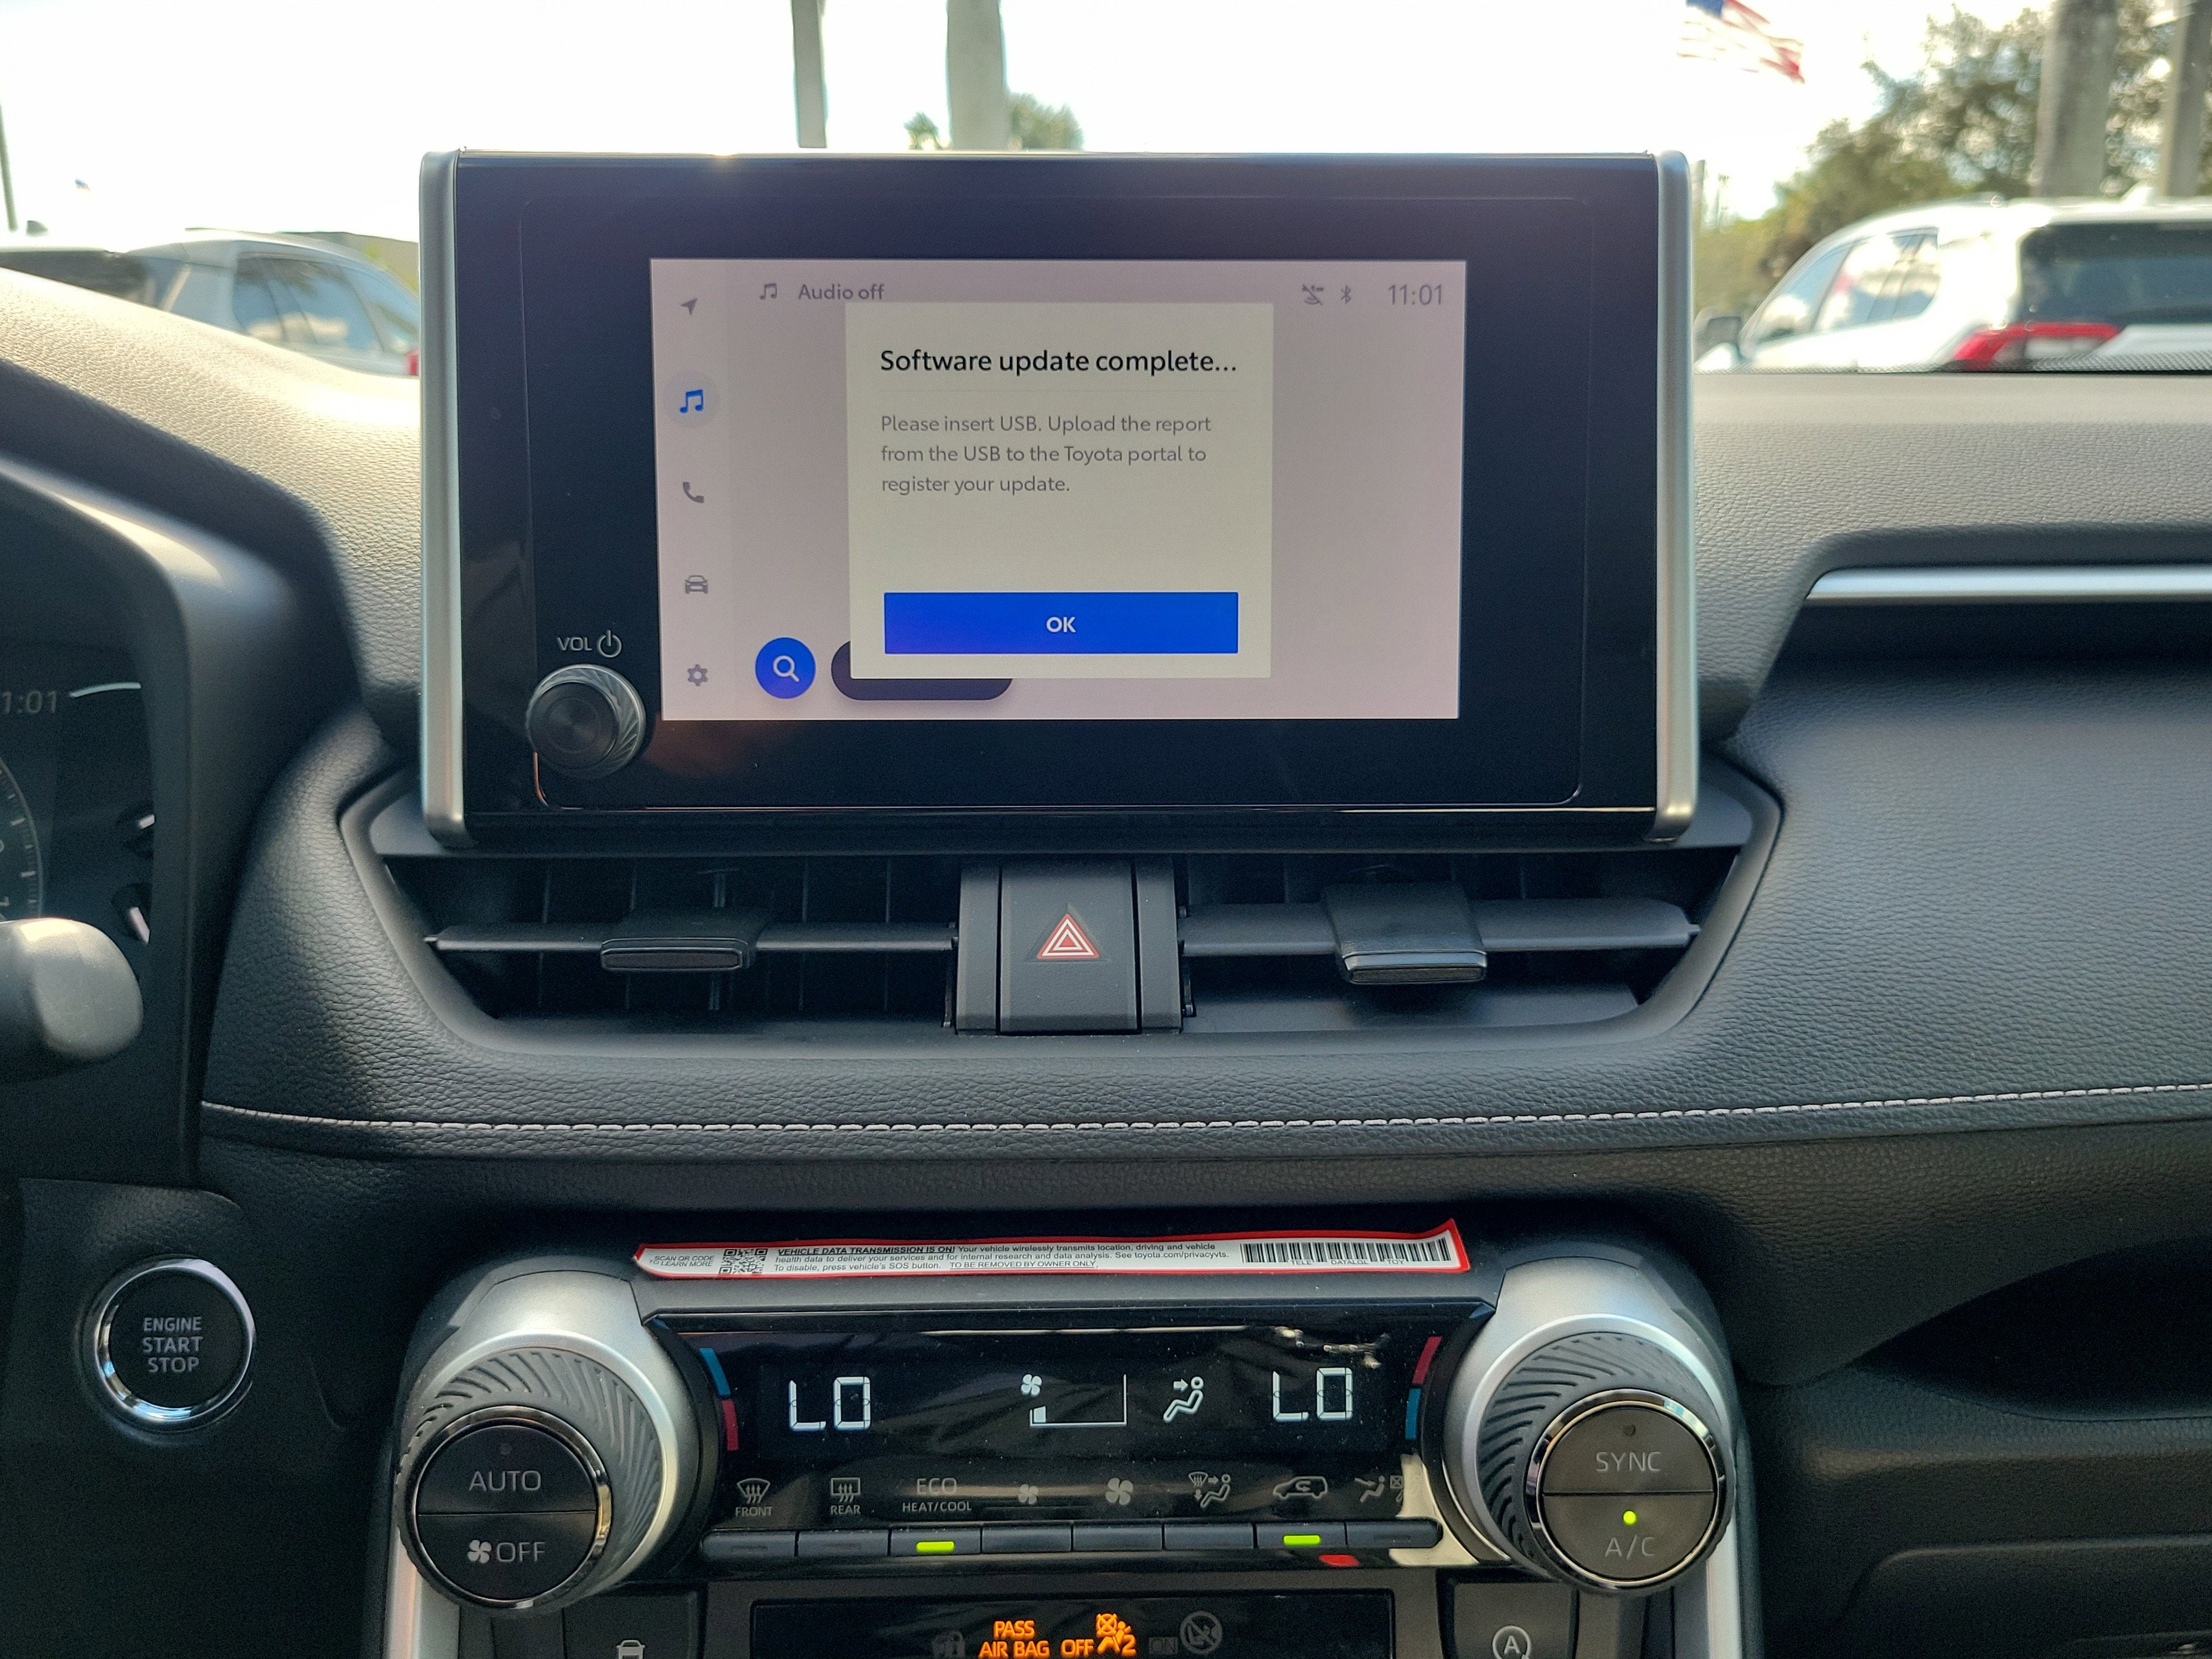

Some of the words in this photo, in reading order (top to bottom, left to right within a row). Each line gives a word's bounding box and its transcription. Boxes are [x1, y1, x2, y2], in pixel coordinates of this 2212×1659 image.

[798, 284, 853, 301] Audio
[857, 283, 885, 301] off
[1387, 284, 1444, 306] 11:01
[880, 349, 992, 372] Software
[999, 349, 1089, 377] update
[881, 416, 940, 432] Please
[944, 416, 995, 432] insert
[1000, 416, 1042, 432] USB.
[1048, 416, 1116, 436] Upload
[1121, 415, 1151, 432] the
[1155, 417, 1212, 435] report
[881, 445, 924, 462] from
[928, 445, 958, 462] the
[963, 447, 1001, 462] USB
[1006, 448, 1024, 462] to
[1029, 445, 1059, 462] the
[1064, 446, 1123, 466] Toyota
[1128, 445, 1183, 466] portal
[1188, 448, 1206, 462] to
[881, 477, 950, 496] register
[953, 480, 995, 496] your
[1000, 477, 1070, 496] update.
[1046, 616, 1076, 633] OK
[557, 636, 592, 651] VOL
[850, 1246, 924, 1254] TRANSMISSION
[786, 1263, 820, 1272] disable,
[143, 1316, 202, 1333] ENGINE
[143, 1335, 204, 1354] START
[148, 1356, 200, 1373] STOP
[788, 1375, 871, 1432] LO
[1272, 1367, 1353, 1422] LO
[1596, 1451, 1662, 1472] SYNC
[468, 1470, 542, 1492] AUTO
[917, 1477, 957, 1496] ECO
[735, 1506, 774, 1517] FRONT
[830, 1504, 861, 1515] REAR
[902, 1501, 972, 1513] HEAT/COOL
[496, 1542, 546, 1563] OFF
[1605, 1536, 1656, 1561] A/C
[993, 1620, 1035, 1639] PASS
[979, 1640, 1008, 1658] AIR
[1013, 1639, 1049, 1658] BAG
[1060, 1638, 1094, 1657] OFF
